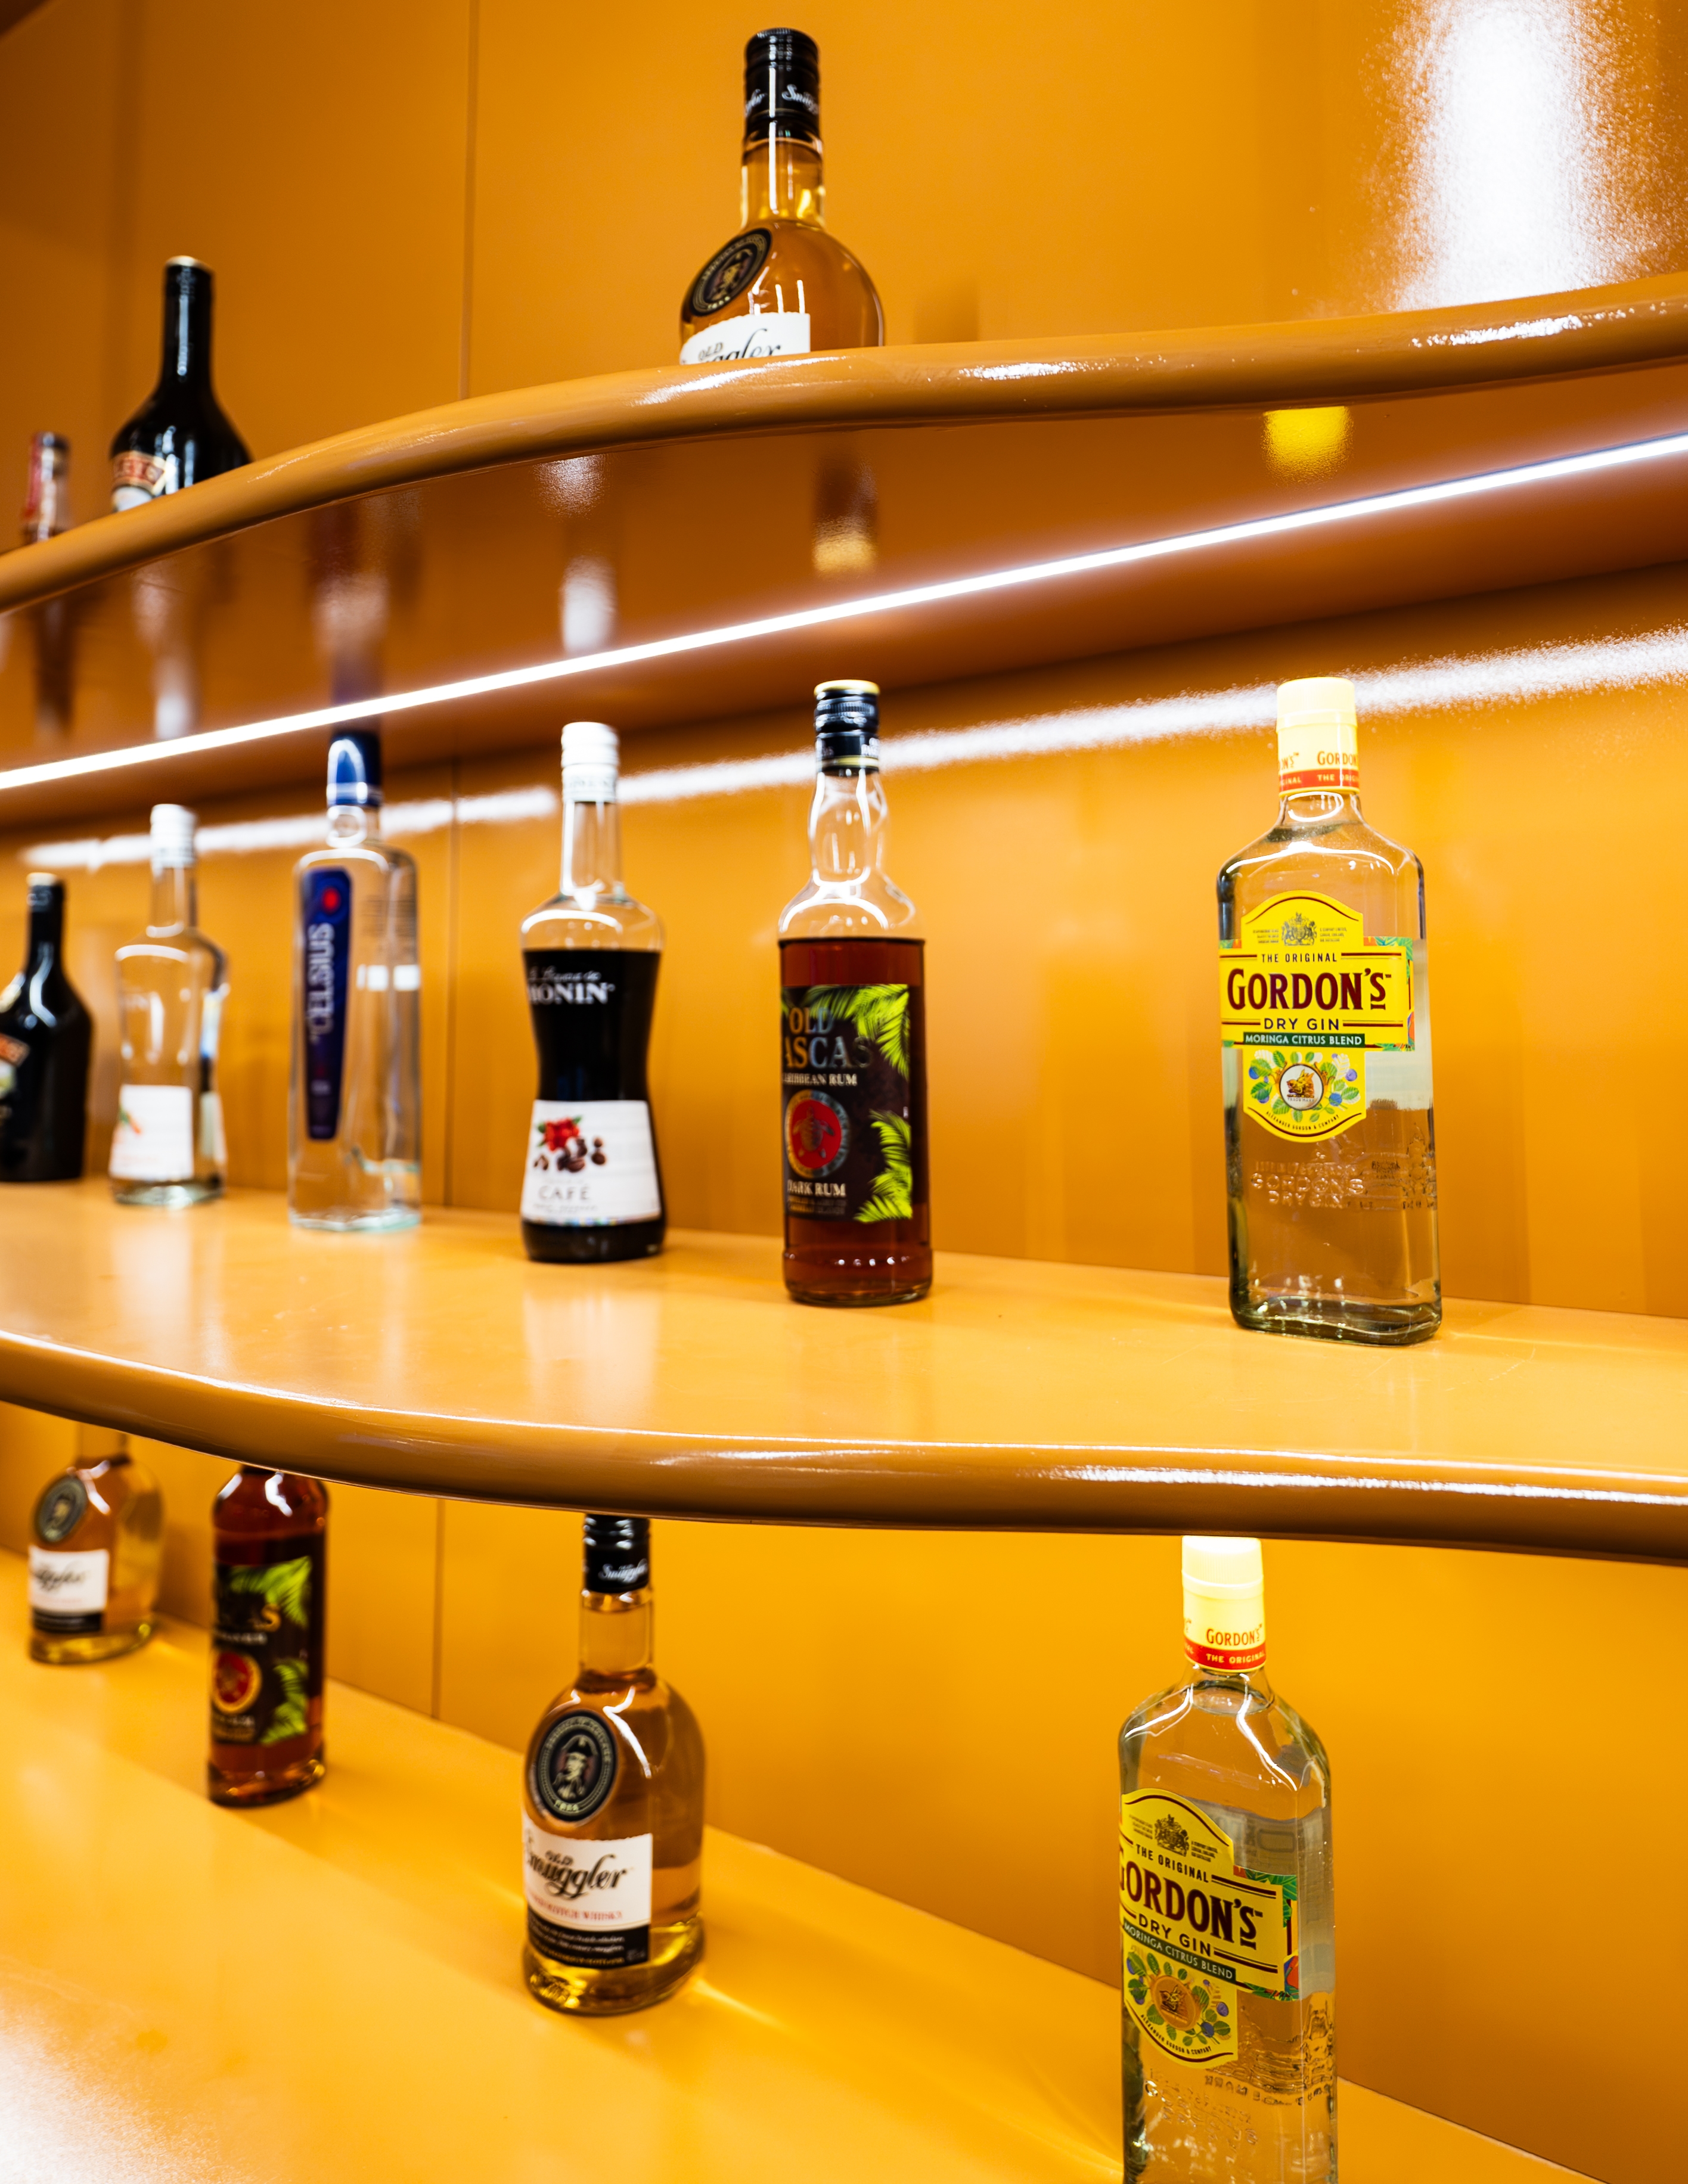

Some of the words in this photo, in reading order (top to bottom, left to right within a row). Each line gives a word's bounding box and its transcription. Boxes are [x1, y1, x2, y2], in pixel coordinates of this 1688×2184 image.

[699, 342, 724, 361] OLD
[1262, 953, 1279, 963] THE
[1285, 953, 1337, 963] ORIGINAL
[1227, 968, 1386, 1011] GORDON'S
[789, 1007, 833, 1034] OLD
[1264, 1018, 1298, 1030] DRY
[1307, 1018, 1339, 1030] GIN
[1245, 1033, 1289, 1045] MORINGA
[1292, 1034, 1326, 1045] CITRUS
[1330, 1036, 1362, 1046] BLEND
[829, 1073, 858, 1086] RUM
[787, 1179, 813, 1195] DARK
[815, 1183, 846, 1197] RUM
[1206, 1627, 1260, 1646] GORDON'S
[1206, 1653, 1225, 1663] THE
[1136, 1844, 1154, 1861] THE
[1158, 1854, 1209, 1884] ORIGINAL
[1122, 1860, 1256, 1950] ORDON'S
[1138, 1913, 1172, 1940] DRY
[1179, 1934, 1211, 1957] GIN
[1124, 1921, 1163, 1951] MORINGA
[1165, 1944, 1199, 1967] CITRUS
[1201, 1959, 1233, 1980] BLEND
